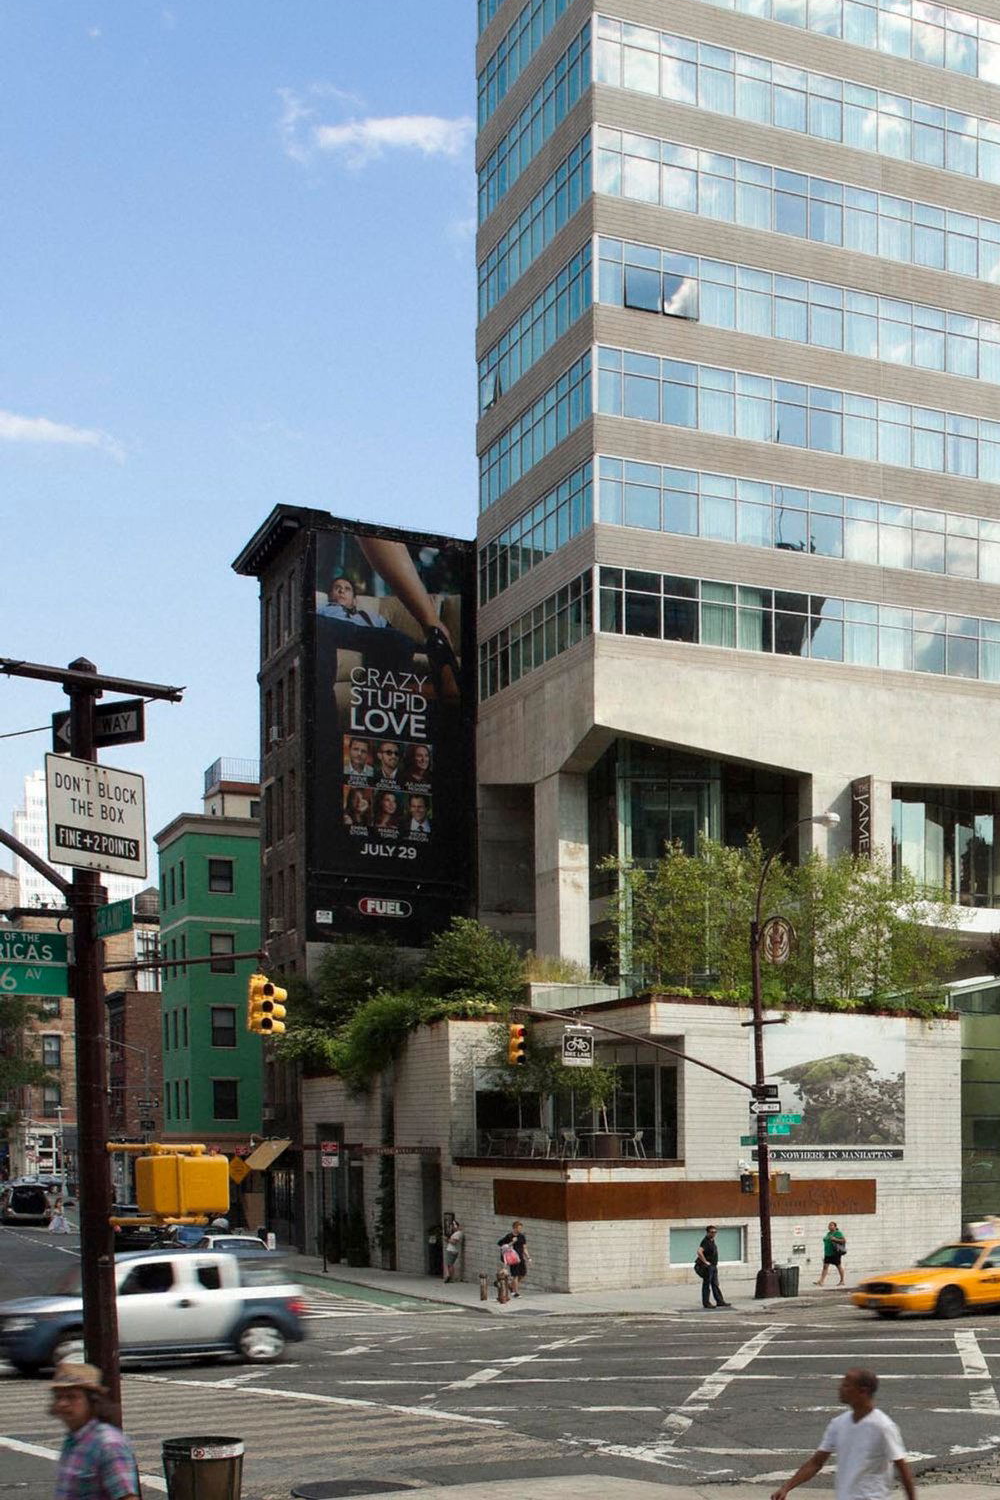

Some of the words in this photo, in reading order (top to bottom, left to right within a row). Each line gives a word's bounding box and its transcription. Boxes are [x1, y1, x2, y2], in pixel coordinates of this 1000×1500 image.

[350, 666, 428, 693] CRAZY
[350, 686, 427, 713] STUPID
[102, 712, 131, 733] WAY
[350, 707, 427, 738] LOVE
[55, 772, 91, 795] DON'T
[98, 782, 138, 805] BLOCK
[71, 798, 94, 818] THE
[101, 804, 125, 824] BOX
[59, 828, 82, 848] FINE
[102, 837, 137, 858] POINTS
[360, 843, 396, 857] JULY
[398, 846, 417, 859] 29
[366, 900, 404, 915] FUEL
[4, 932, 17, 941] OF
[22, 933, 41, 943] THE
[0, 967, 17, 990] 6
[25, 968, 42, 980] AV
[780, 1151, 825, 1159] NOWHERE
[828, 1151, 838, 1159] IN
[841, 1151, 893, 1159] MANHATTAN
